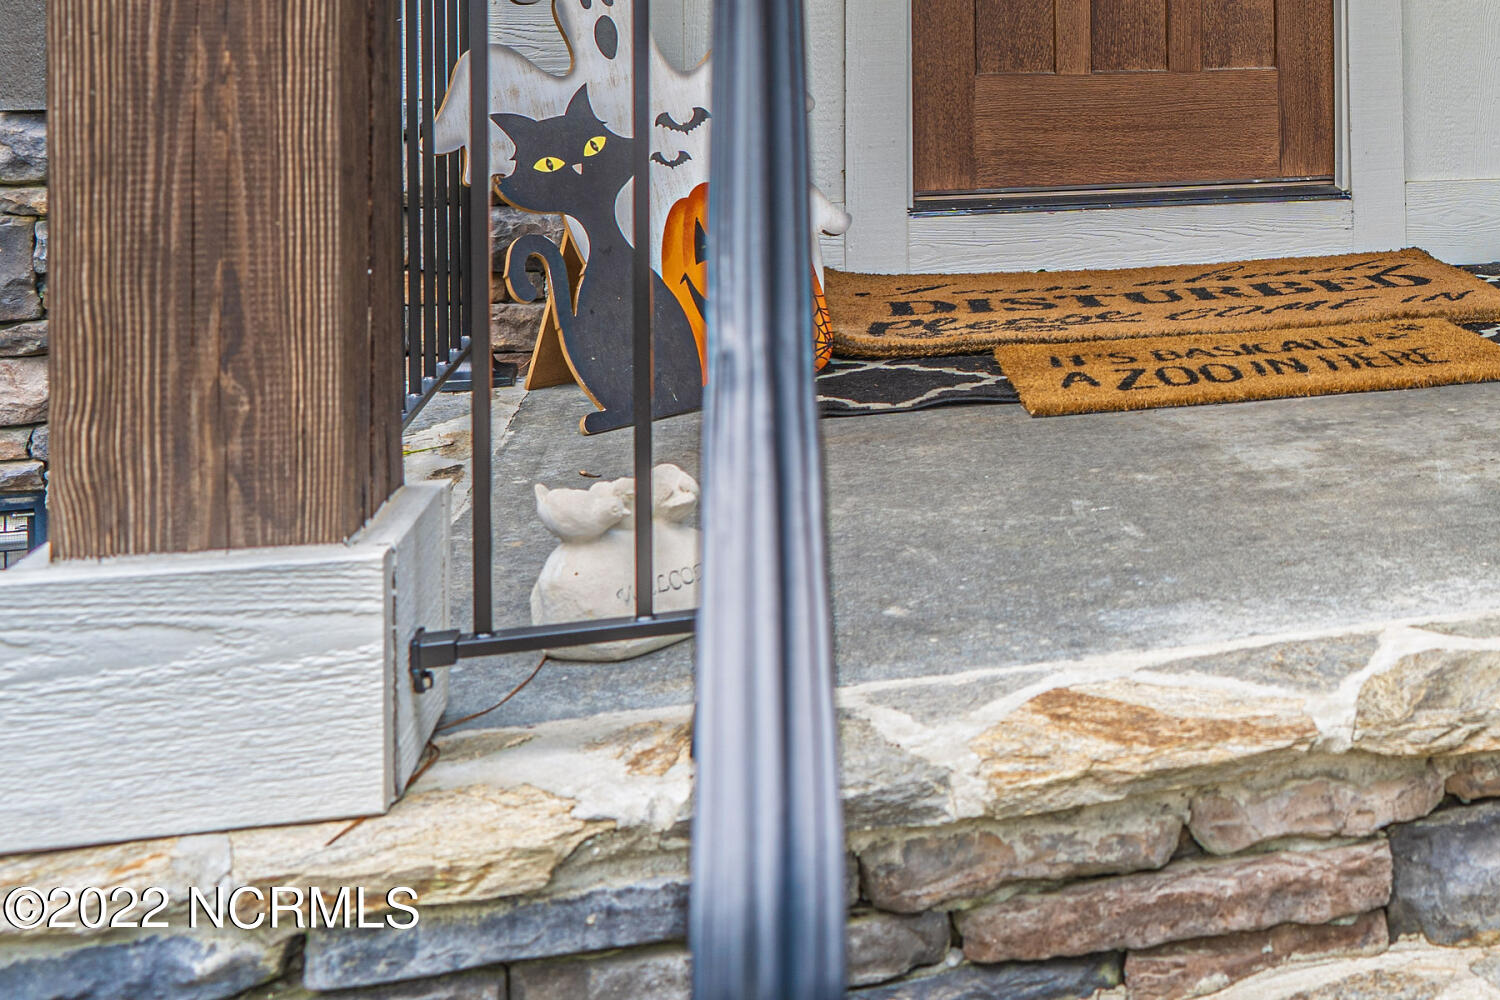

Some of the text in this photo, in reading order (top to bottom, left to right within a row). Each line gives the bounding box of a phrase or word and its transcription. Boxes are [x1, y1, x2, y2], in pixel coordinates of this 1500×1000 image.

[887, 264, 1432, 317] DISTURBED
[1050, 336, 1373, 368] IT'S BASICALLY
[1061, 346, 1451, 391] A ZOO IN HERE
